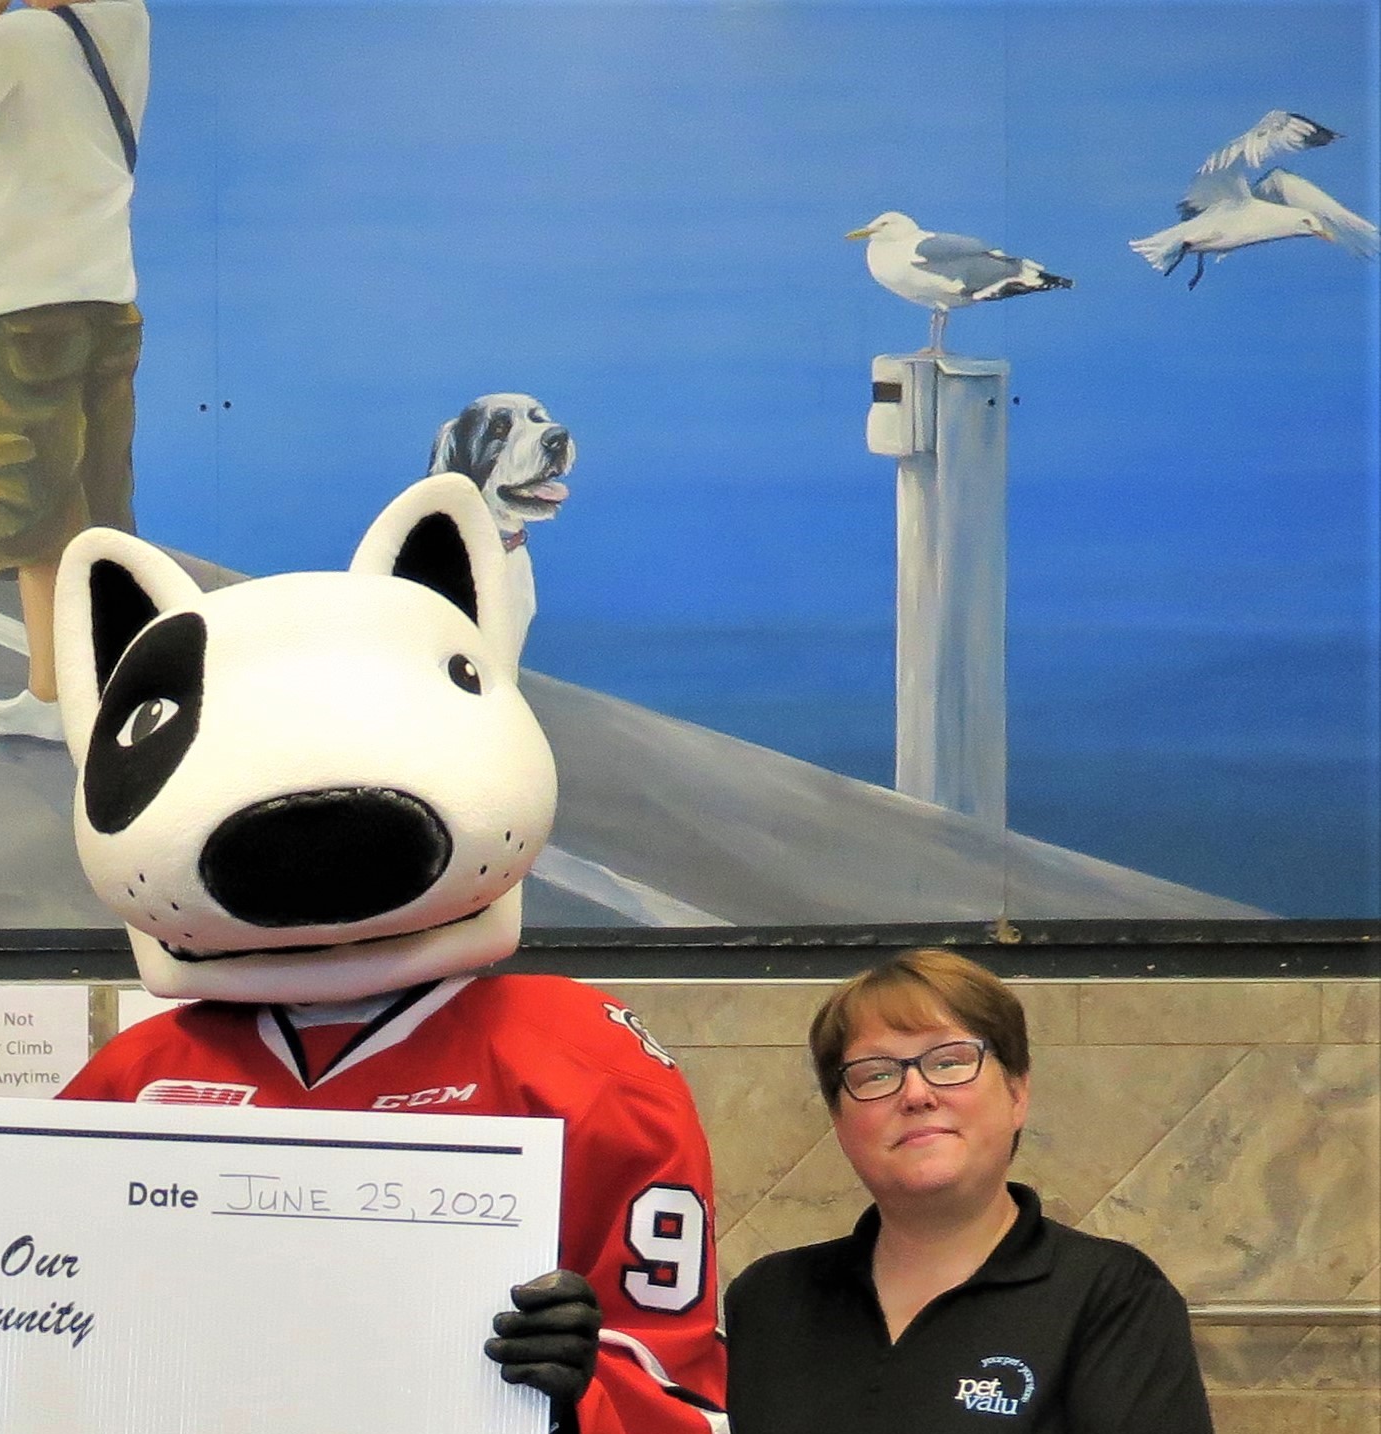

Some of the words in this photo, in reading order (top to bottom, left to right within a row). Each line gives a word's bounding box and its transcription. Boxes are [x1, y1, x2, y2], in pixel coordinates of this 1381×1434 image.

[4, 1012, 34, 1026] Not
[6, 1039, 53, 1055] Climb
[371, 1083, 478, 1109] CCM
[127, 1182, 199, 1208] Date
[219, 1174, 332, 1212] JUNE
[0, 1235, 82, 1279] Our
[623, 1181, 707, 1316] 9
[954, 1378, 1002, 1400] pet
[965, 1391, 1019, 1415] valu
